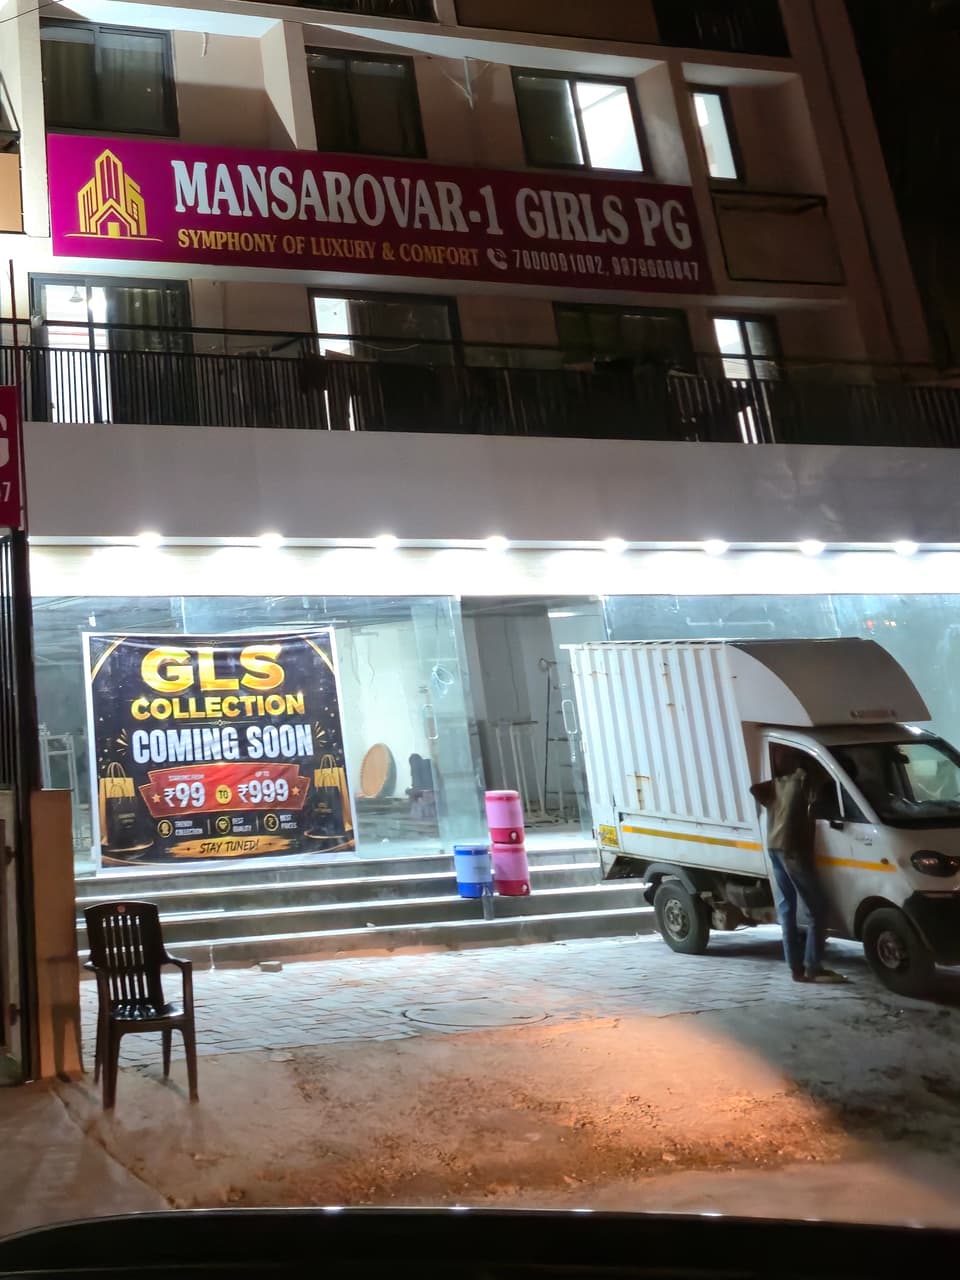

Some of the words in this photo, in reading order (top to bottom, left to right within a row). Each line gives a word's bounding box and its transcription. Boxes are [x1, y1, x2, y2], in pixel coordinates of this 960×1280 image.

[170, 160, 504, 235] MANSAROVAR-1
[515, 187, 630, 246] GIRLS
[634, 198, 693, 250] PG
[177, 228, 277, 253] SYMPHONY
[282, 235, 306, 255] OF
[310, 236, 377, 260] LUXURY
[381, 241, 396, 261] &
[398, 243, 480, 267] COMFORT
[141, 644, 286, 694] GLS
[130, 693, 306, 721] COLLECTION
[132, 726, 240, 764] COMING
[245, 723, 315, 759] SOON
[218, 789, 229, 800] TO
[198, 837, 224, 855] STAY
[224, 835, 260, 853] TUNED!
